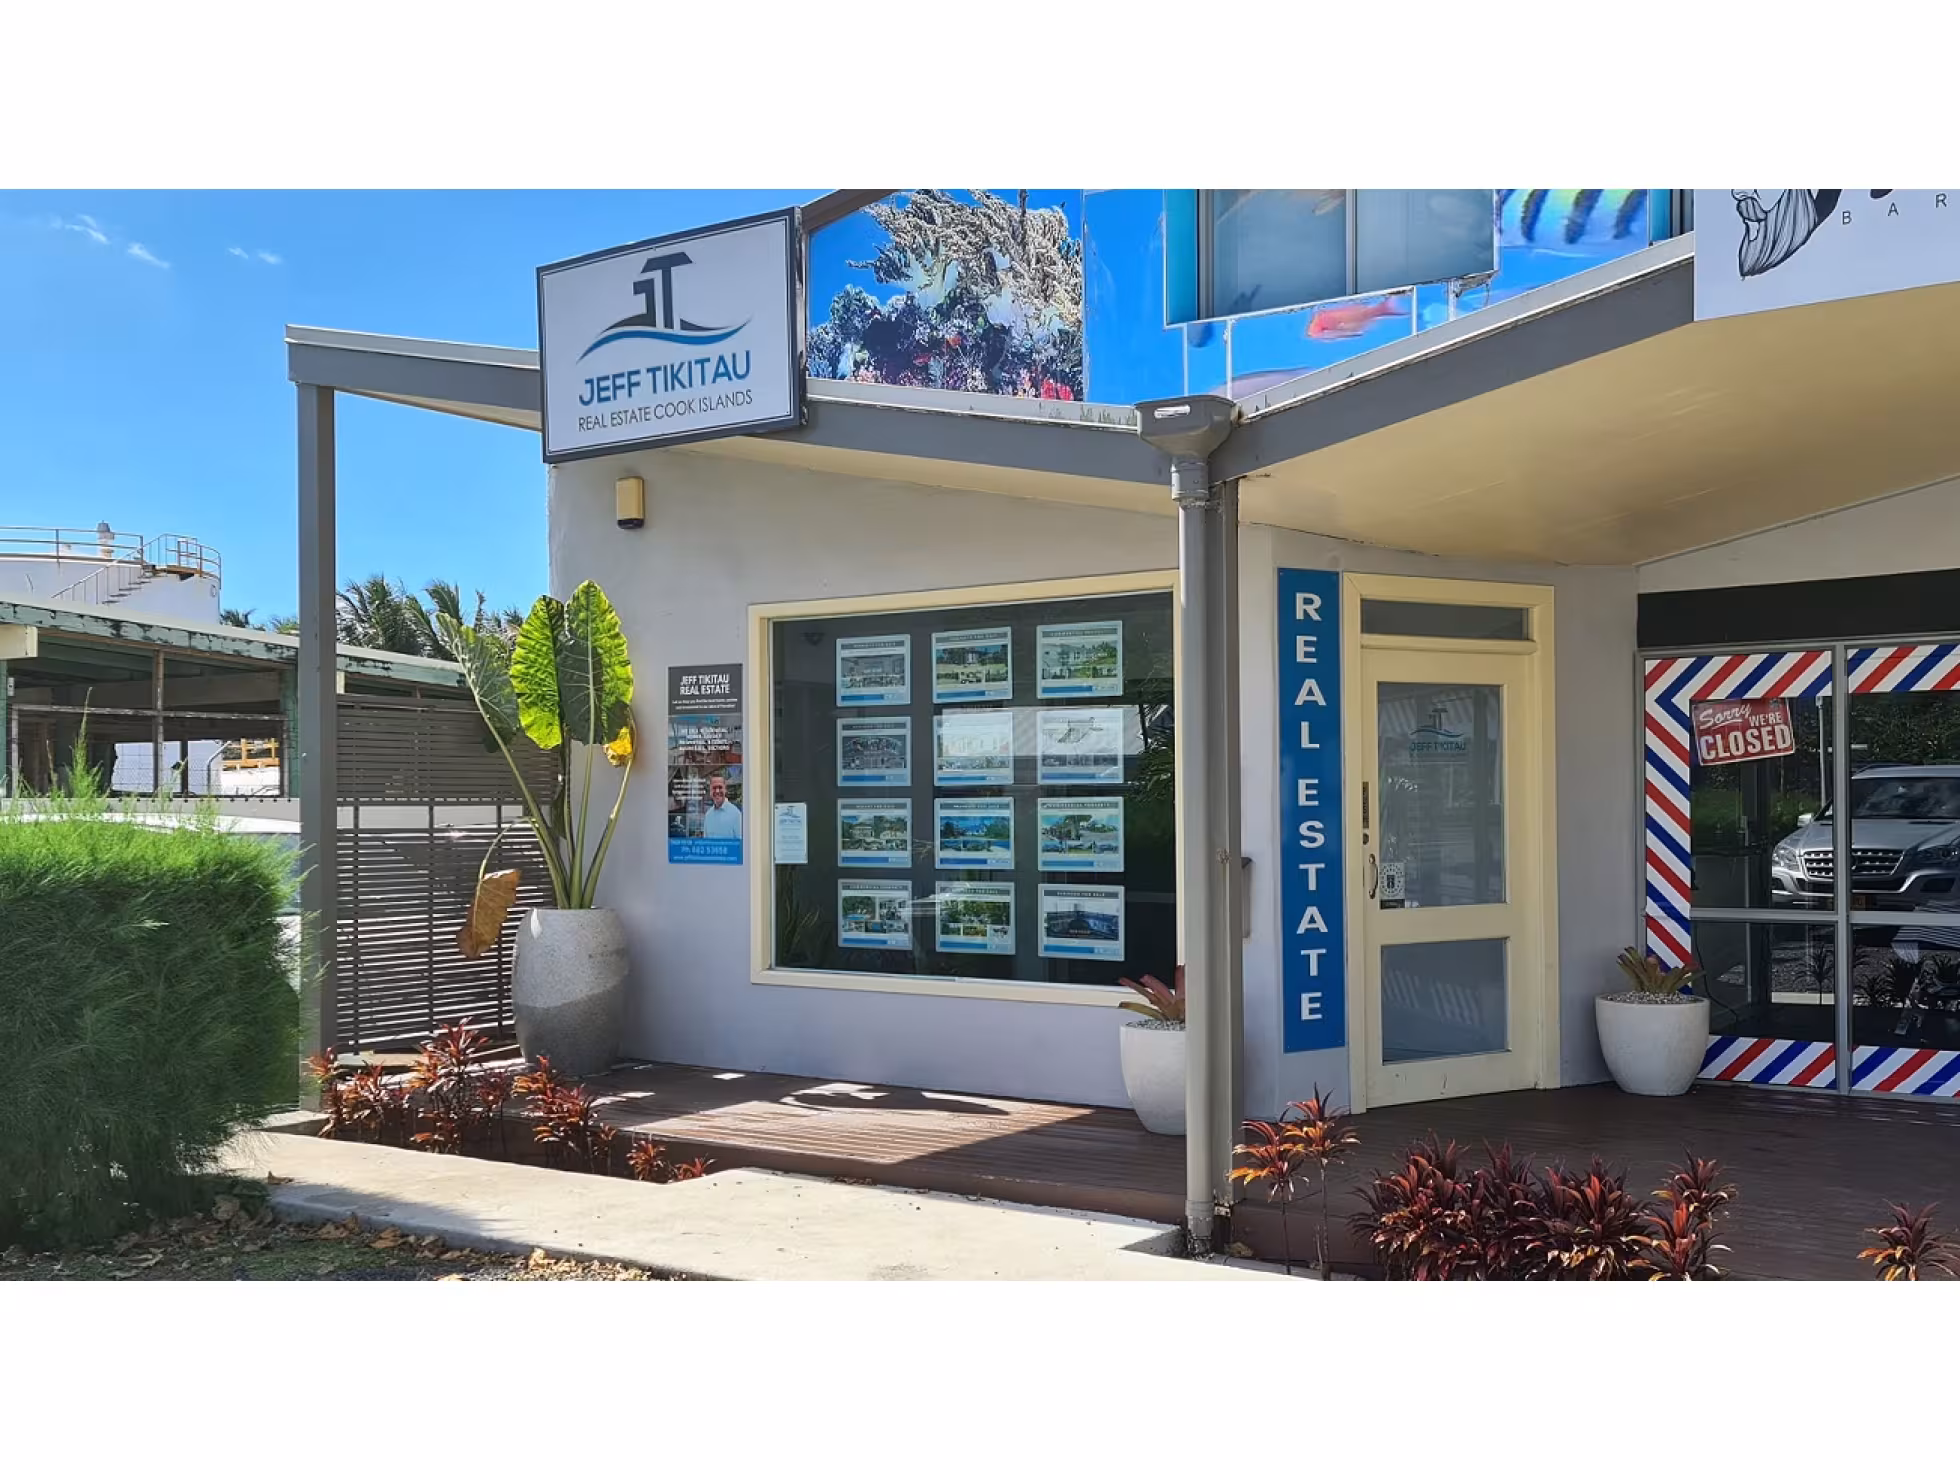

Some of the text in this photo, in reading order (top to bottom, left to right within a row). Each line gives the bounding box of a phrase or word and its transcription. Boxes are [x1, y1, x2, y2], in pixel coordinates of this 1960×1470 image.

[578, 350, 752, 407] JEFF TIKITAU
[578, 389, 753, 432] REAL ESTATE COOK ISLANDS
[679, 683, 731, 695] REAL ESTATE
[680, 673, 730, 686] JEFF TIKITAU
[1699, 703, 1752, 730] Sorry
[1749, 711, 1783, 727] WE'RE
[1409, 741, 1433, 752] JEFF
[1700, 723, 1791, 761] CLOSED
[1294, 592, 1328, 1022] REAL ESTATE
